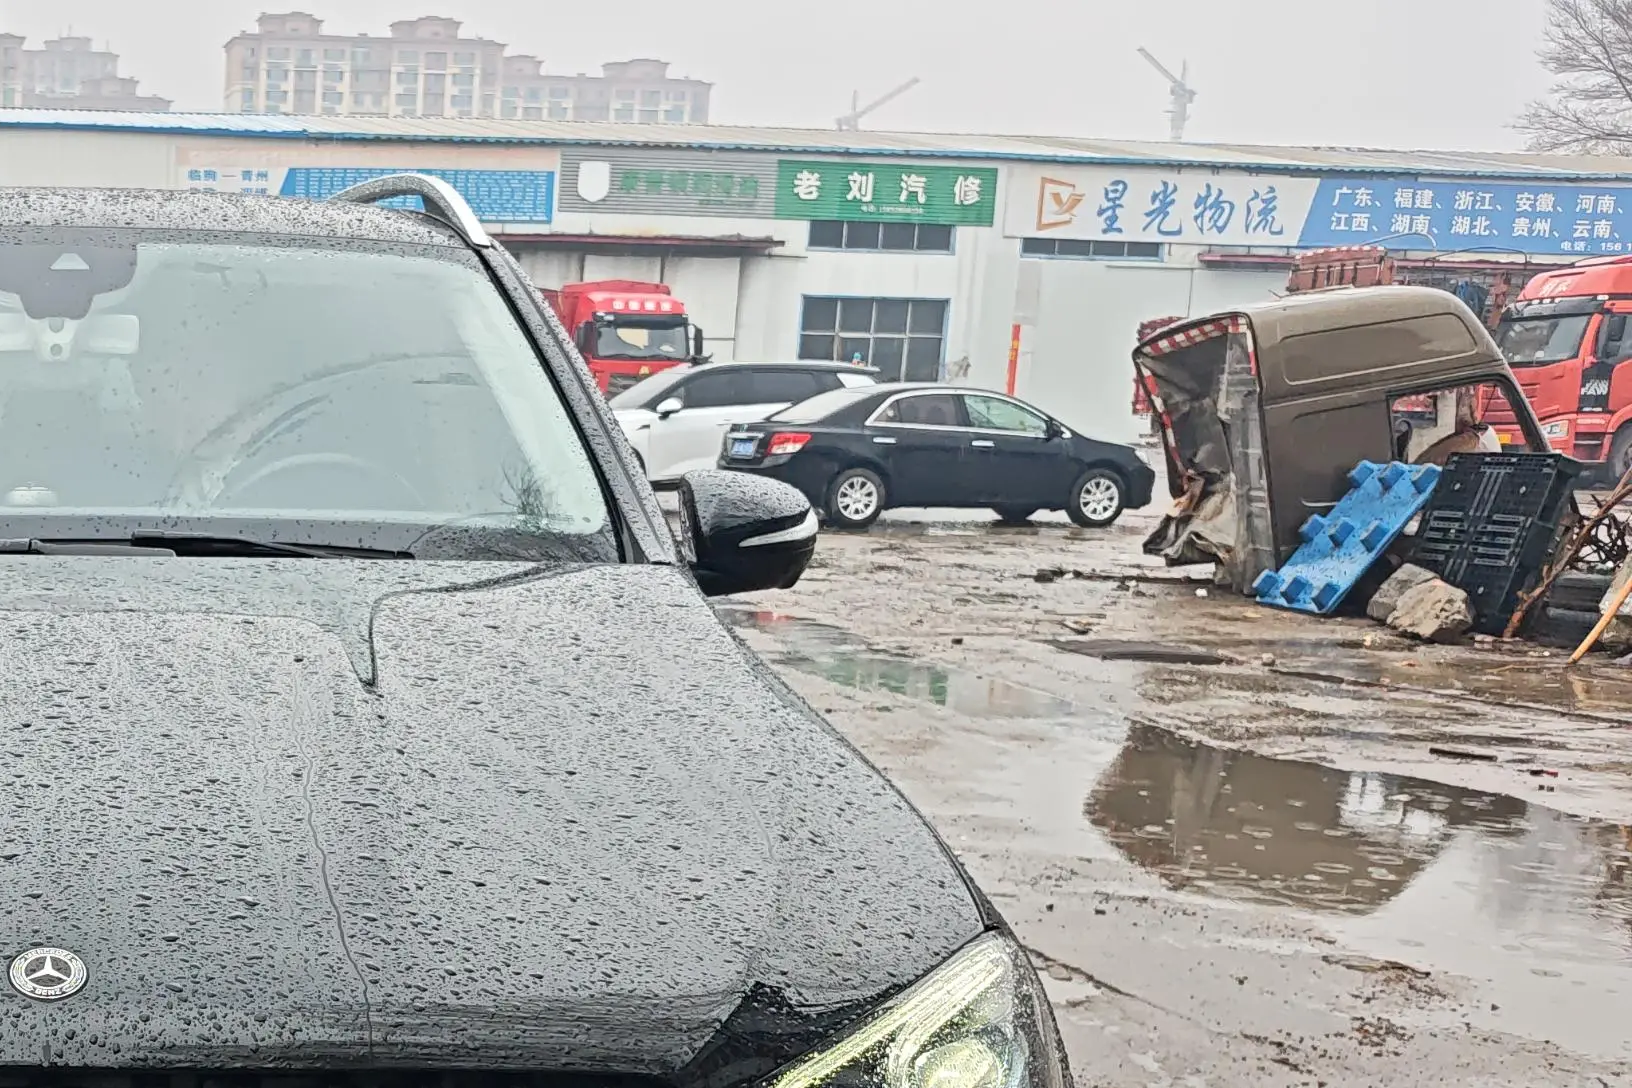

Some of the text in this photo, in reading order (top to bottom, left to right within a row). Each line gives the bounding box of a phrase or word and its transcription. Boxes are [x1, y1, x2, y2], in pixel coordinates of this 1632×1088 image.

[793, 170, 982, 206] 老刘汽修
[1097, 179, 1284, 236] 星光物流
